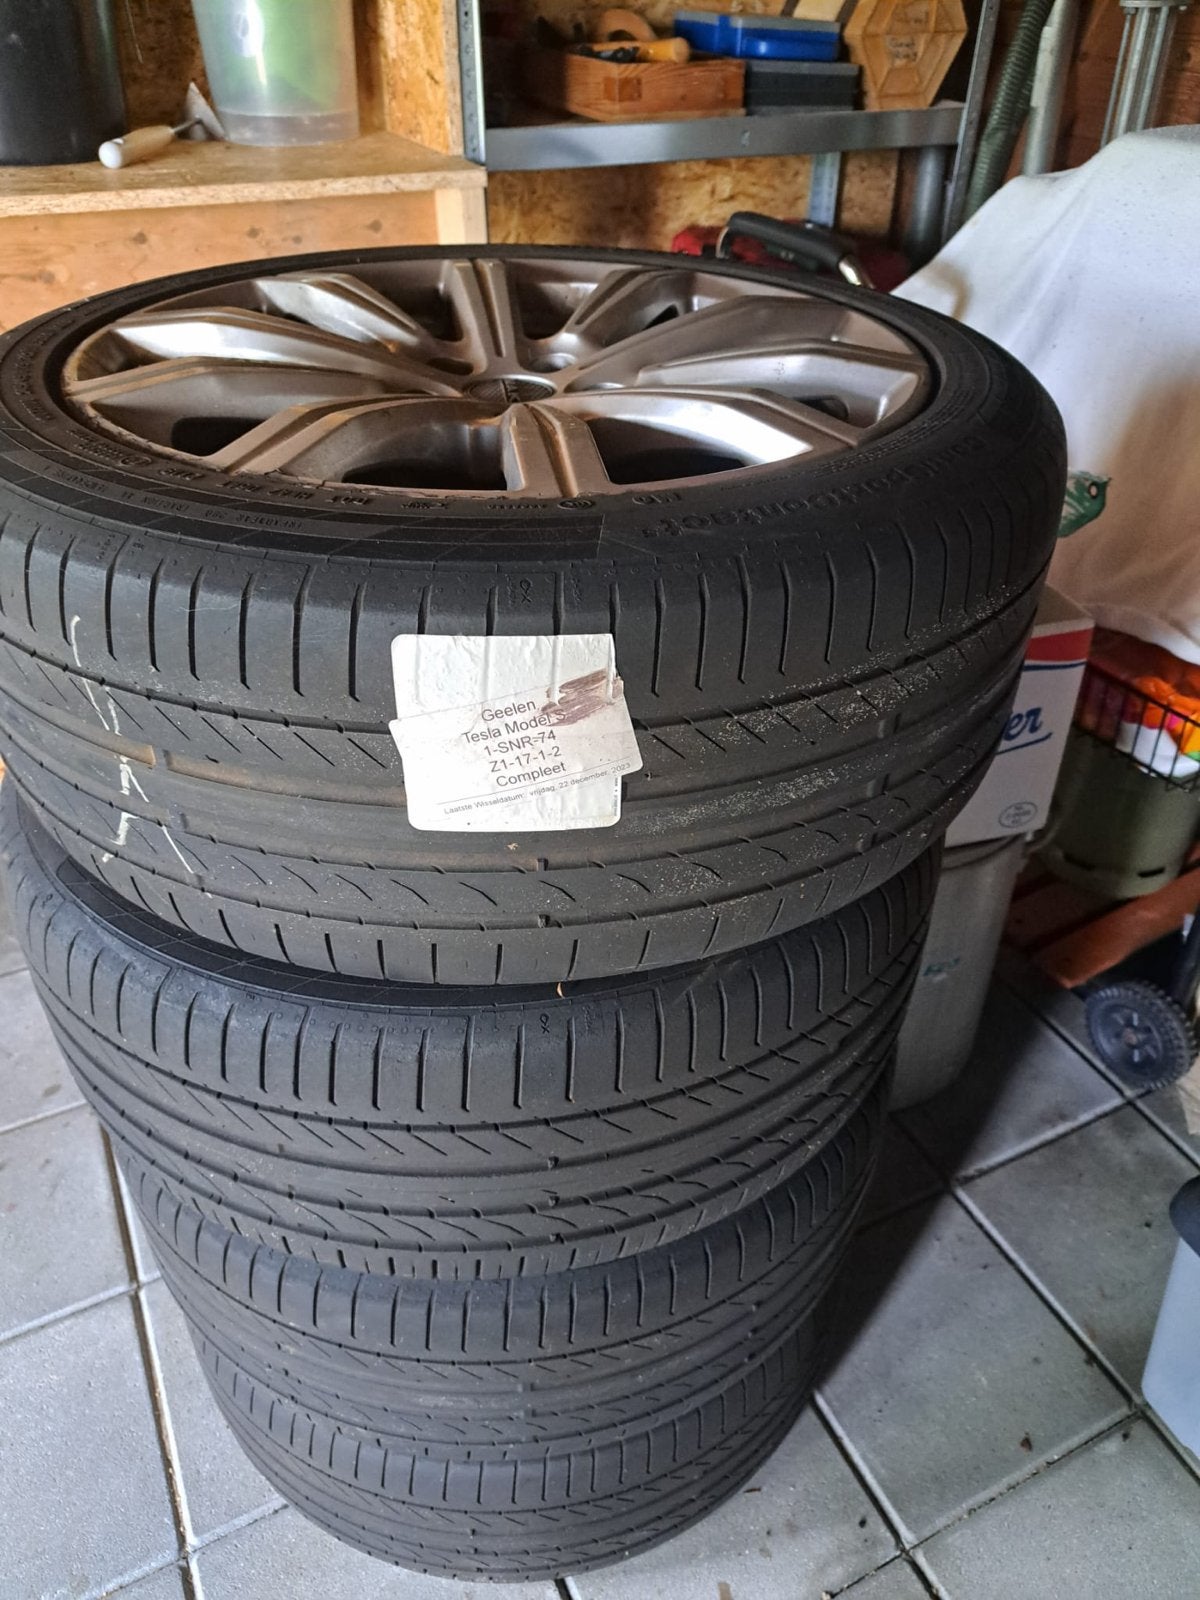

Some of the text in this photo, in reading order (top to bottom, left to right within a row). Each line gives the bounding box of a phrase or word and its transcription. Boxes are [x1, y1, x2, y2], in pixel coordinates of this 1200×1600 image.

[481, 700, 536, 721] Geelen
[462, 709, 566, 743] Tesla Model S
[484, 729, 556, 756] 1-SNR-74
[489, 745, 562, 773] Z1-17-1-2
[496, 761, 566, 787] Compleet
[444, 804, 473, 815] Laatste
[558, 781, 569, 789] 22
[611, 762, 631, 774] 2023
